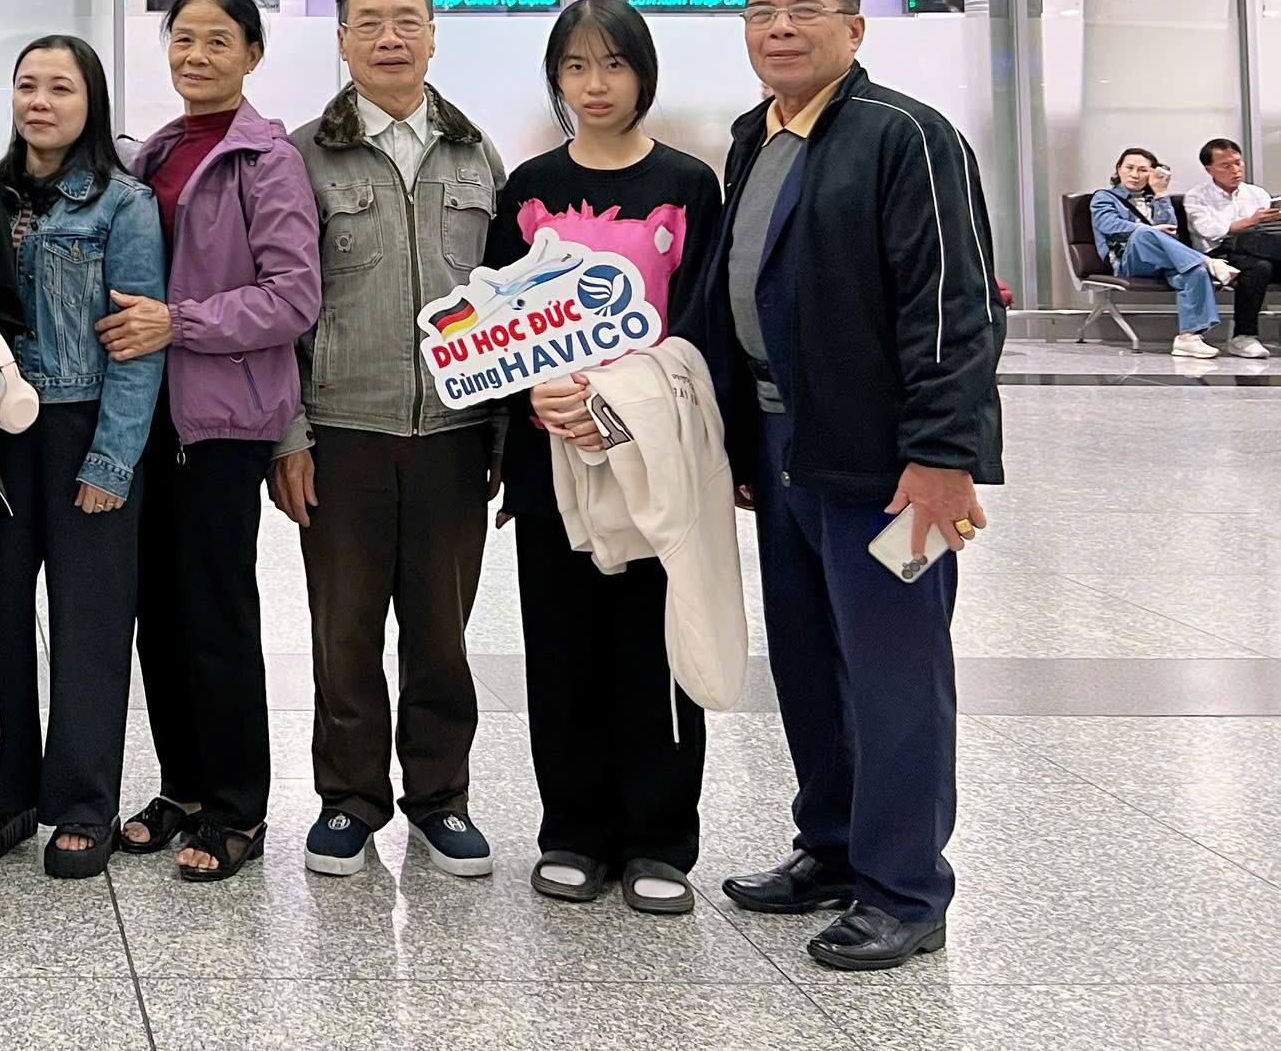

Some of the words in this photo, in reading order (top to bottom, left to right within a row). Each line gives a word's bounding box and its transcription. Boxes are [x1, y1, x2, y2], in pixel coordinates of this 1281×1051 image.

[431, 342, 469, 369] DU
[471, 318, 527, 353] HỌC
[527, 298, 582, 336] ĐỨC
[444, 366, 503, 400] Cùng
[499, 311, 650, 383] HAVICO
